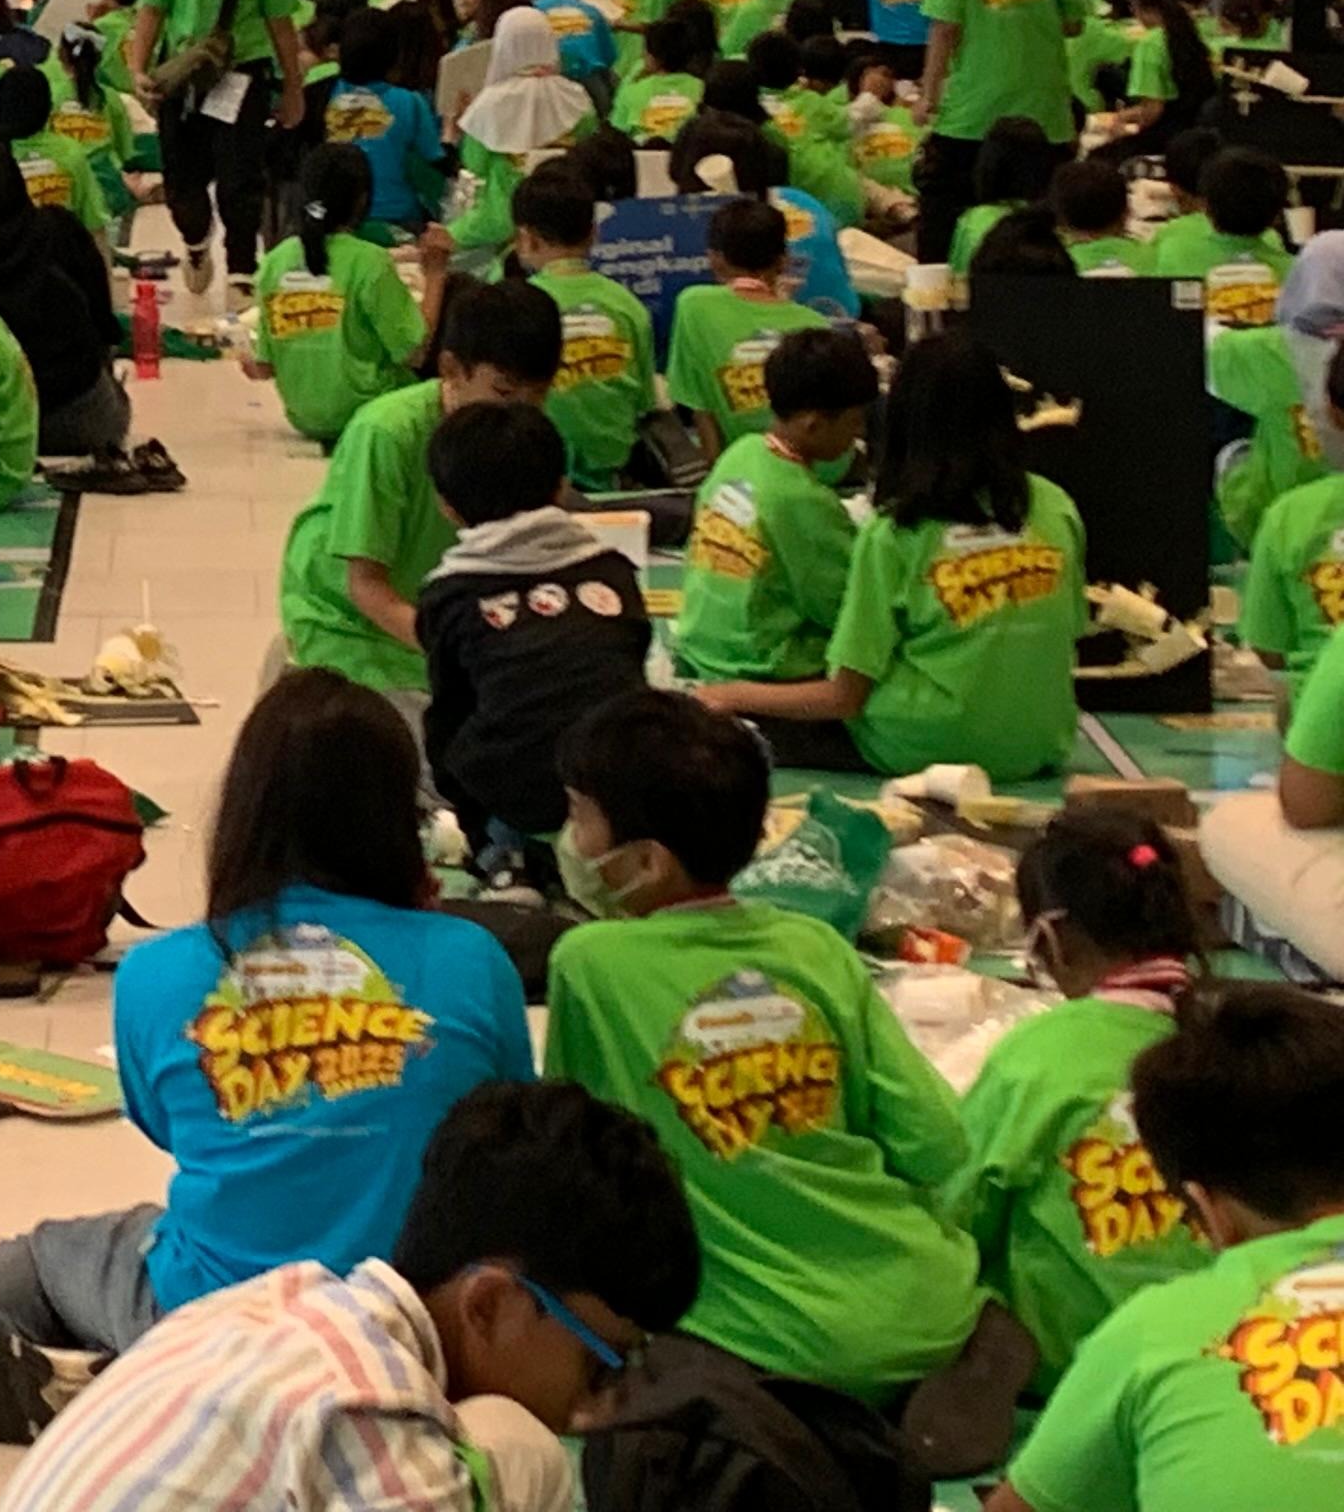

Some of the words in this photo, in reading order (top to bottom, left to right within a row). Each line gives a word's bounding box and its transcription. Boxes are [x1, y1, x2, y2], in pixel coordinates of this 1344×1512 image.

[194, 996, 435, 1076] SCIENCE
[218, 1052, 310, 1122] DAY
[312, 1042, 404, 1077] 2025
[1089, 1191, 1186, 1257] DAY
